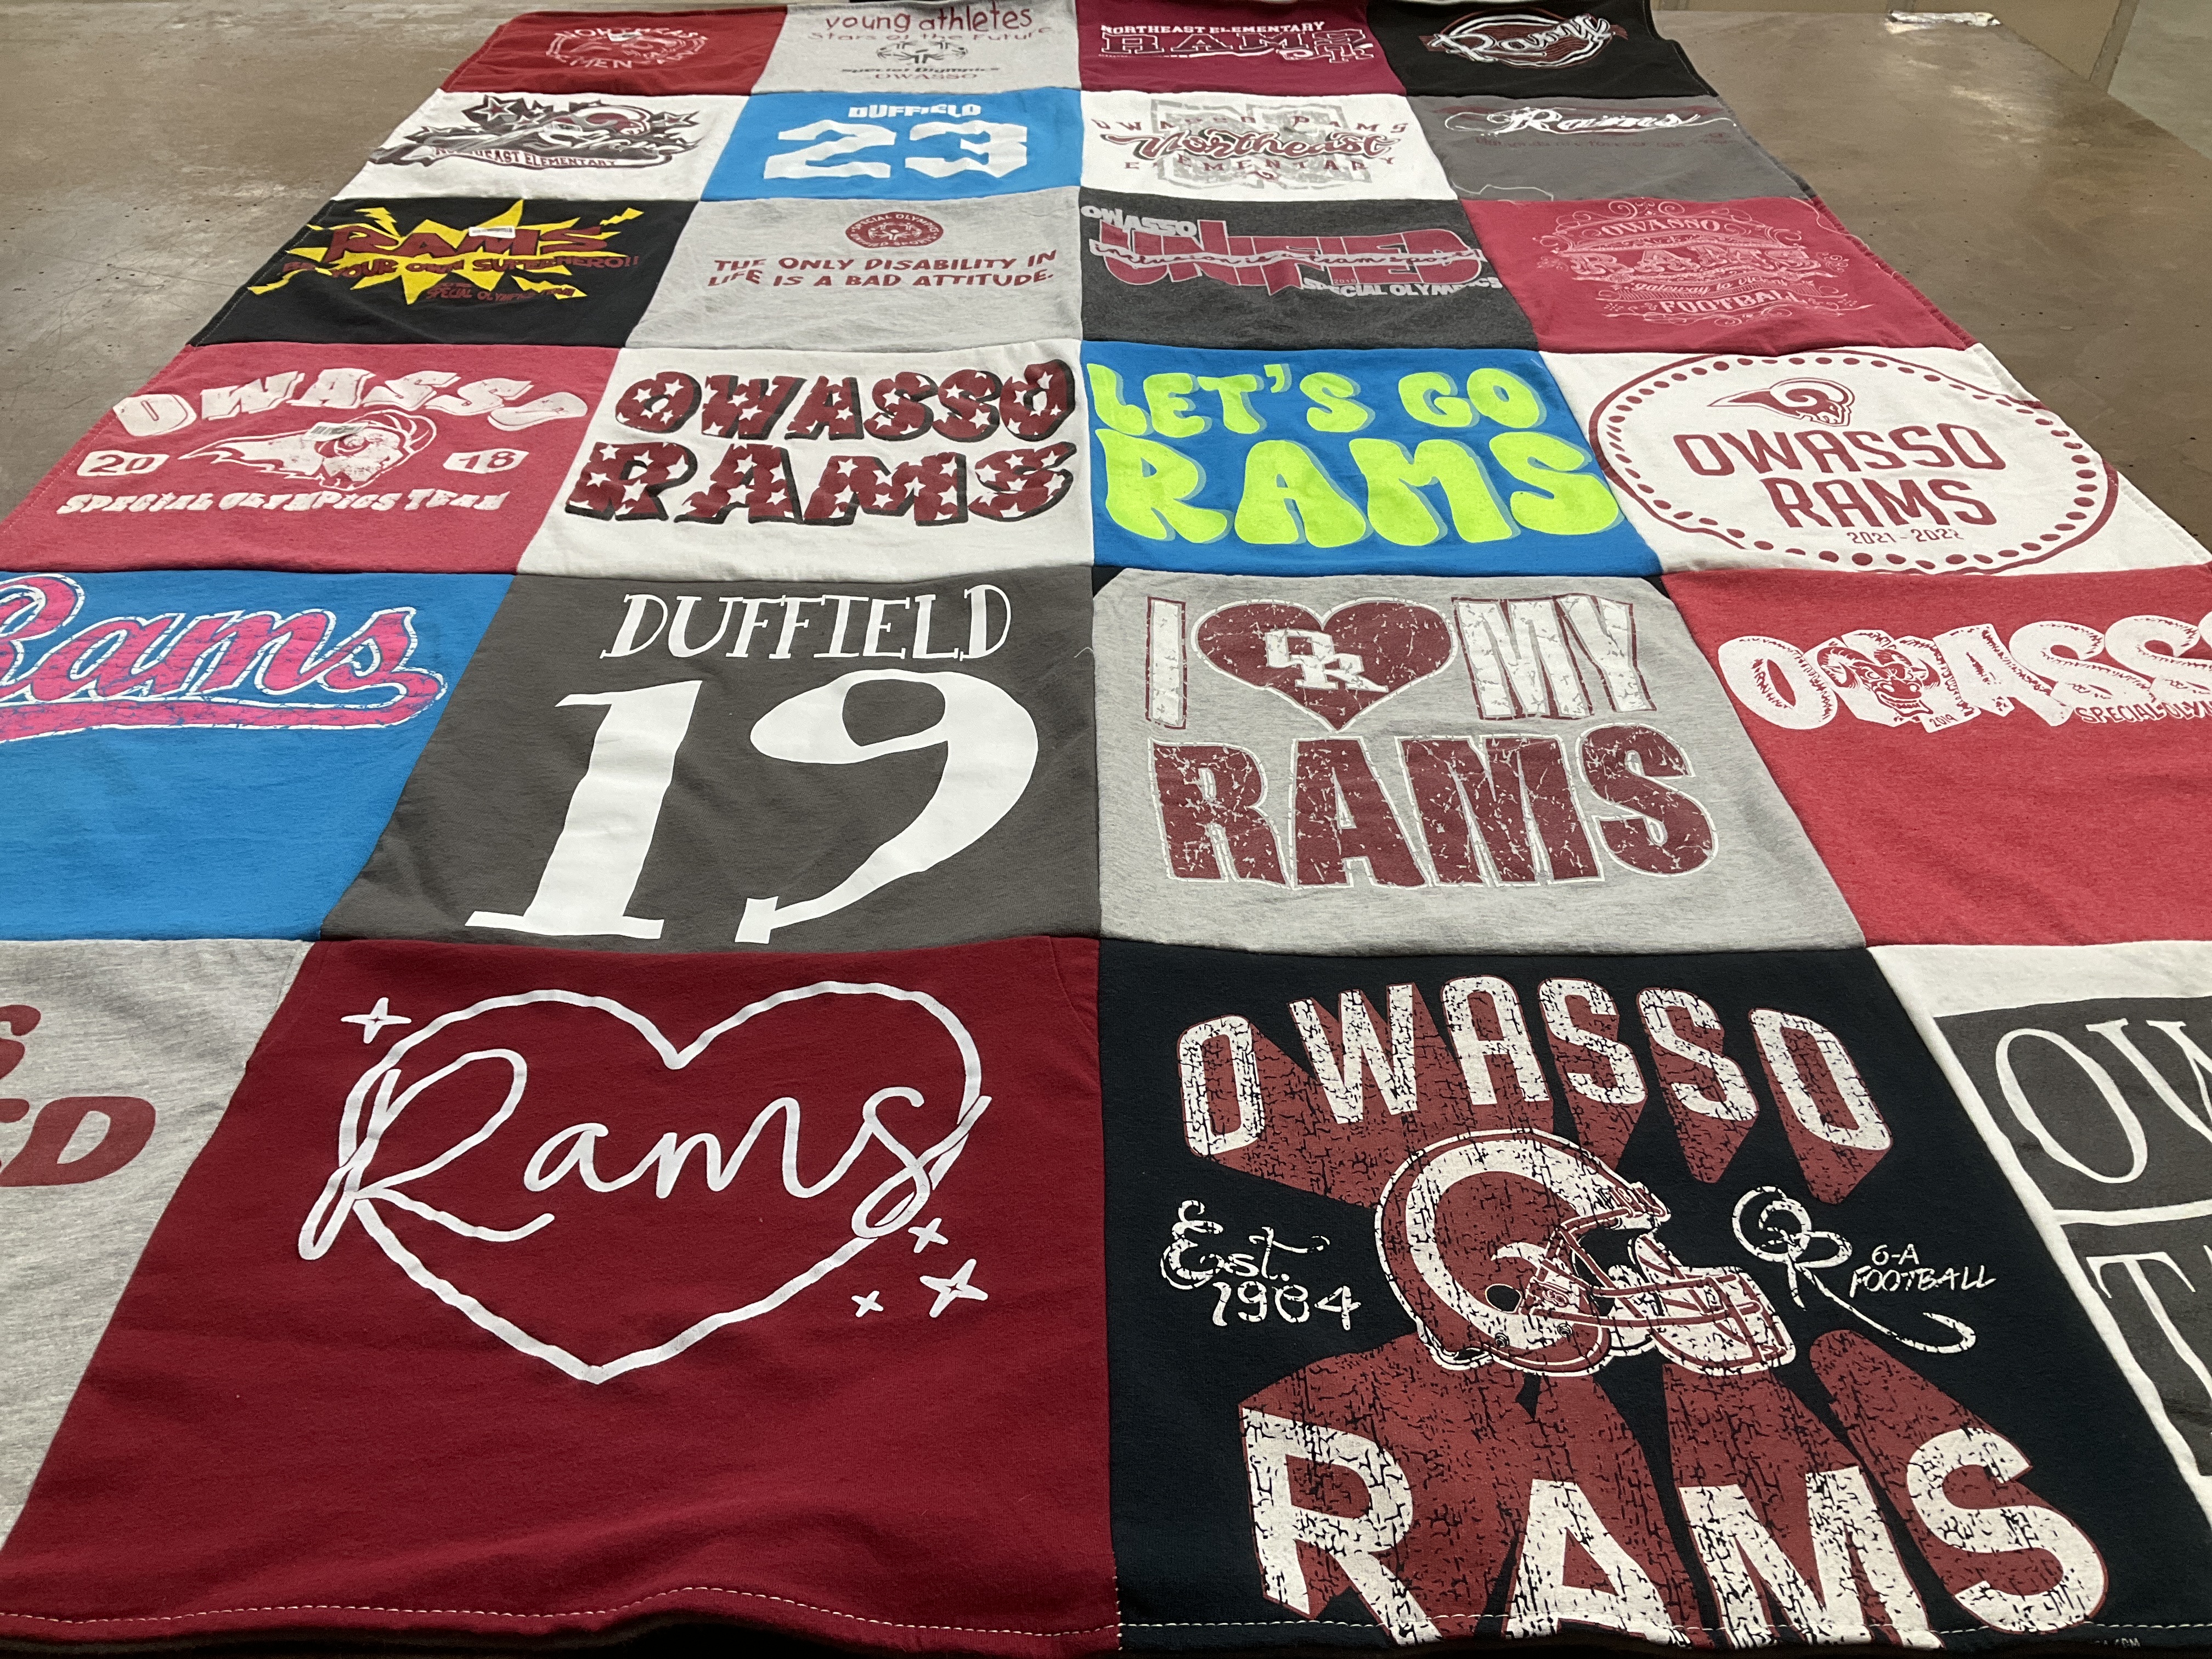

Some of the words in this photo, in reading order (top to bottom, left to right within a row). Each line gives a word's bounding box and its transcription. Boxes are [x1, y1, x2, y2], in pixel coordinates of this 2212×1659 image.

[826, 13, 911, 33] young
[918, 4, 1033, 32] athletes
[922, 32, 963, 41] the
[1101, 25, 1206, 35] NORTHEAST
[1210, 21, 1325, 33] ELEMENTARY
[848, 104, 981, 118] DUFFIELD
[524, 153, 616, 167] ELEMENTARY
[764, 120, 1028, 179] 23
[1101, 126, 1401, 161] Northeast
[1081, 205, 1198, 237] OWASSO
[1601, 218, 1721, 238] OWASSO
[324, 225, 608, 263] RAMS
[714, 258, 767, 271] THE
[778, 257, 855, 270] ONLY
[864, 257, 1017, 270] DISABILITY
[1027, 250, 1057, 268] IN
[707, 269, 764, 286] LIFE
[773, 275, 805, 287] IS
[813, 275, 833, 287] A
[845, 273, 901, 287] BAD
[1302, 277, 1388, 297] SPECIAL
[1389, 276, 1503, 297] OLYMPICS
[1659, 290, 1809, 313] FOOTBALL
[112, 368, 588, 436] OWASSO
[615, 359, 1075, 443] OWASSO
[1087, 363, 1375, 439] LET'S
[1397, 367, 1547, 430] GO
[94, 453, 155, 473] 20
[457, 450, 515, 469] 18
[1672, 422, 2006, 476] OWASSO
[565, 441, 1077, 527] RAMS
[1095, 428, 1625, 548] RAMS
[1759, 477, 1997, 528] RAMS
[599, 584, 1012, 662] DUFFIELD
[1146, 596, 1187, 730] I
[1452, 593, 1657, 720] MY
[1718, 611, 2212, 730] OWASS
[1929, 714, 1959, 728] 2019
[2073, 703, 2166, 724] SPECIAL
[465, 668, 1039, 945] 19
[1148, 722, 1719, 891] RAMS
[1177, 974, 1893, 1159] OWASSO
[298, 1048, 992, 1261] Rams
[1160, 1199, 1331, 1290] Est.
[1871, 1244, 1920, 1267] 6-A
[1849, 1265, 1996, 1297] FOOTBALL
[1241, 1406, 2109, 1649] RAMS
